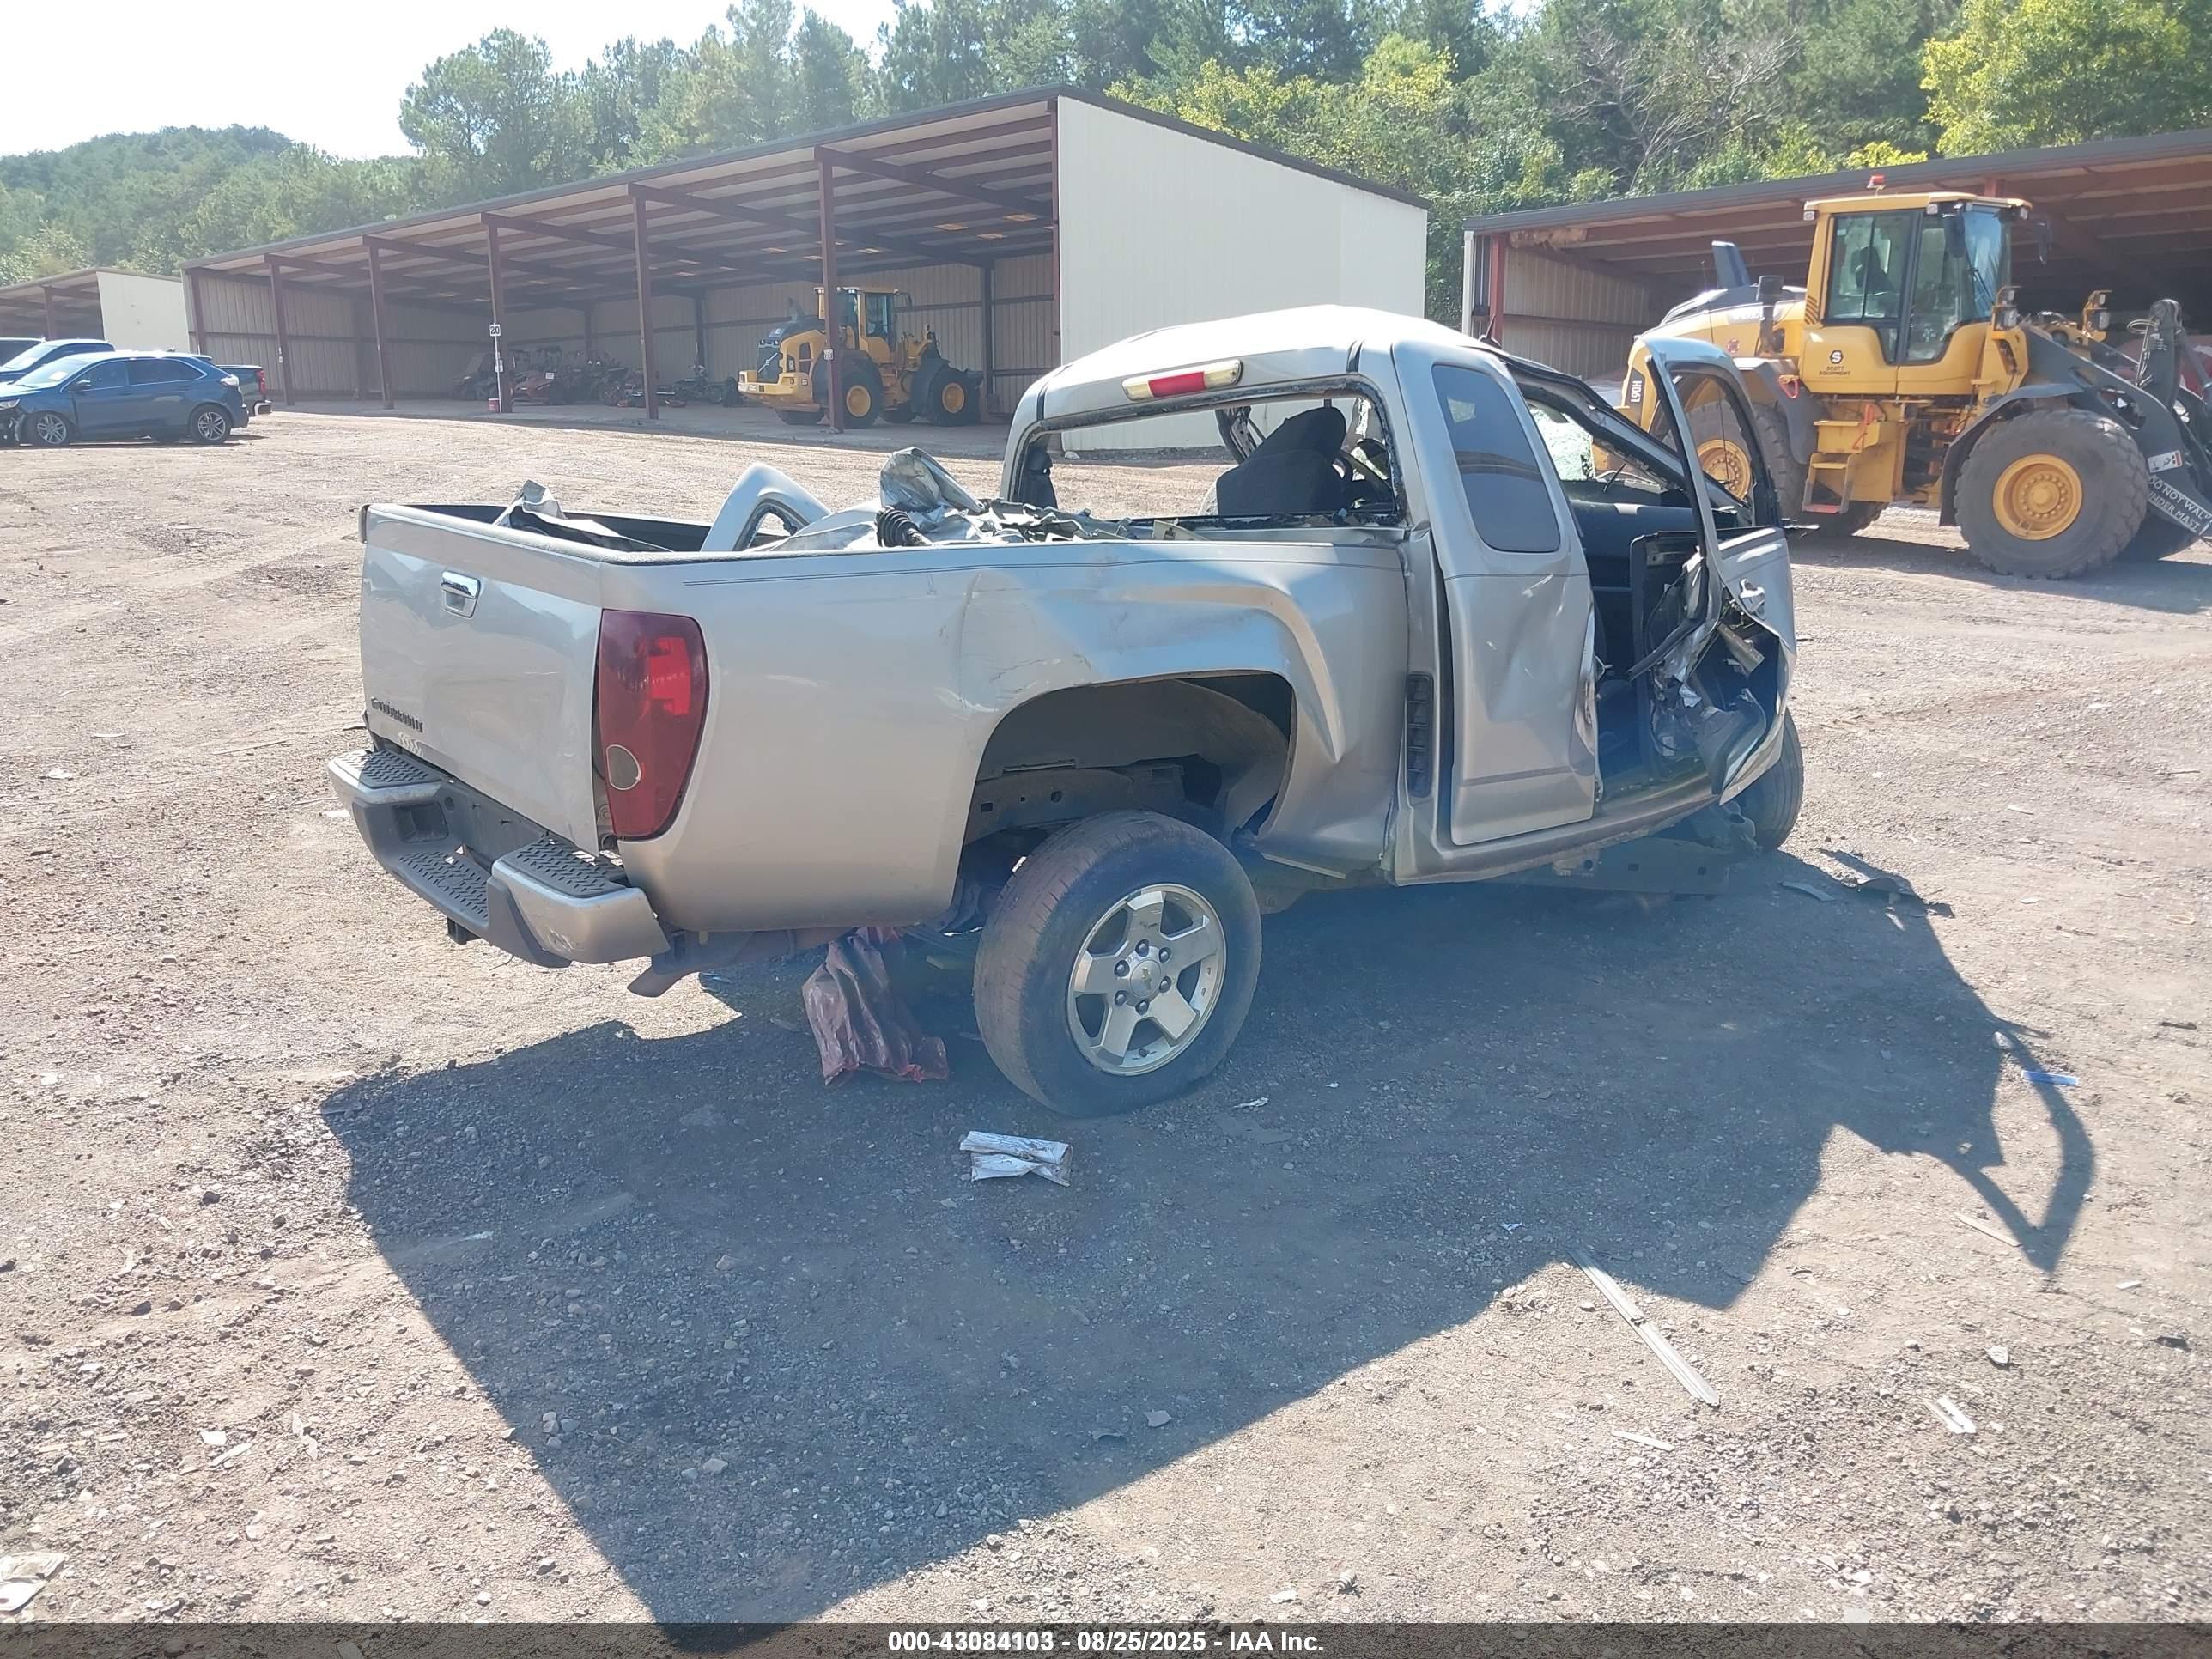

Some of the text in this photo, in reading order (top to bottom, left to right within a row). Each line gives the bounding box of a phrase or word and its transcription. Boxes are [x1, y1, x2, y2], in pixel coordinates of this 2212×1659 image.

[490, 325, 500, 335] 20
[1631, 380, 1642, 403] L90H
[2162, 486, 2186, 503] NOT
[2175, 510, 2201, 530] MAST
